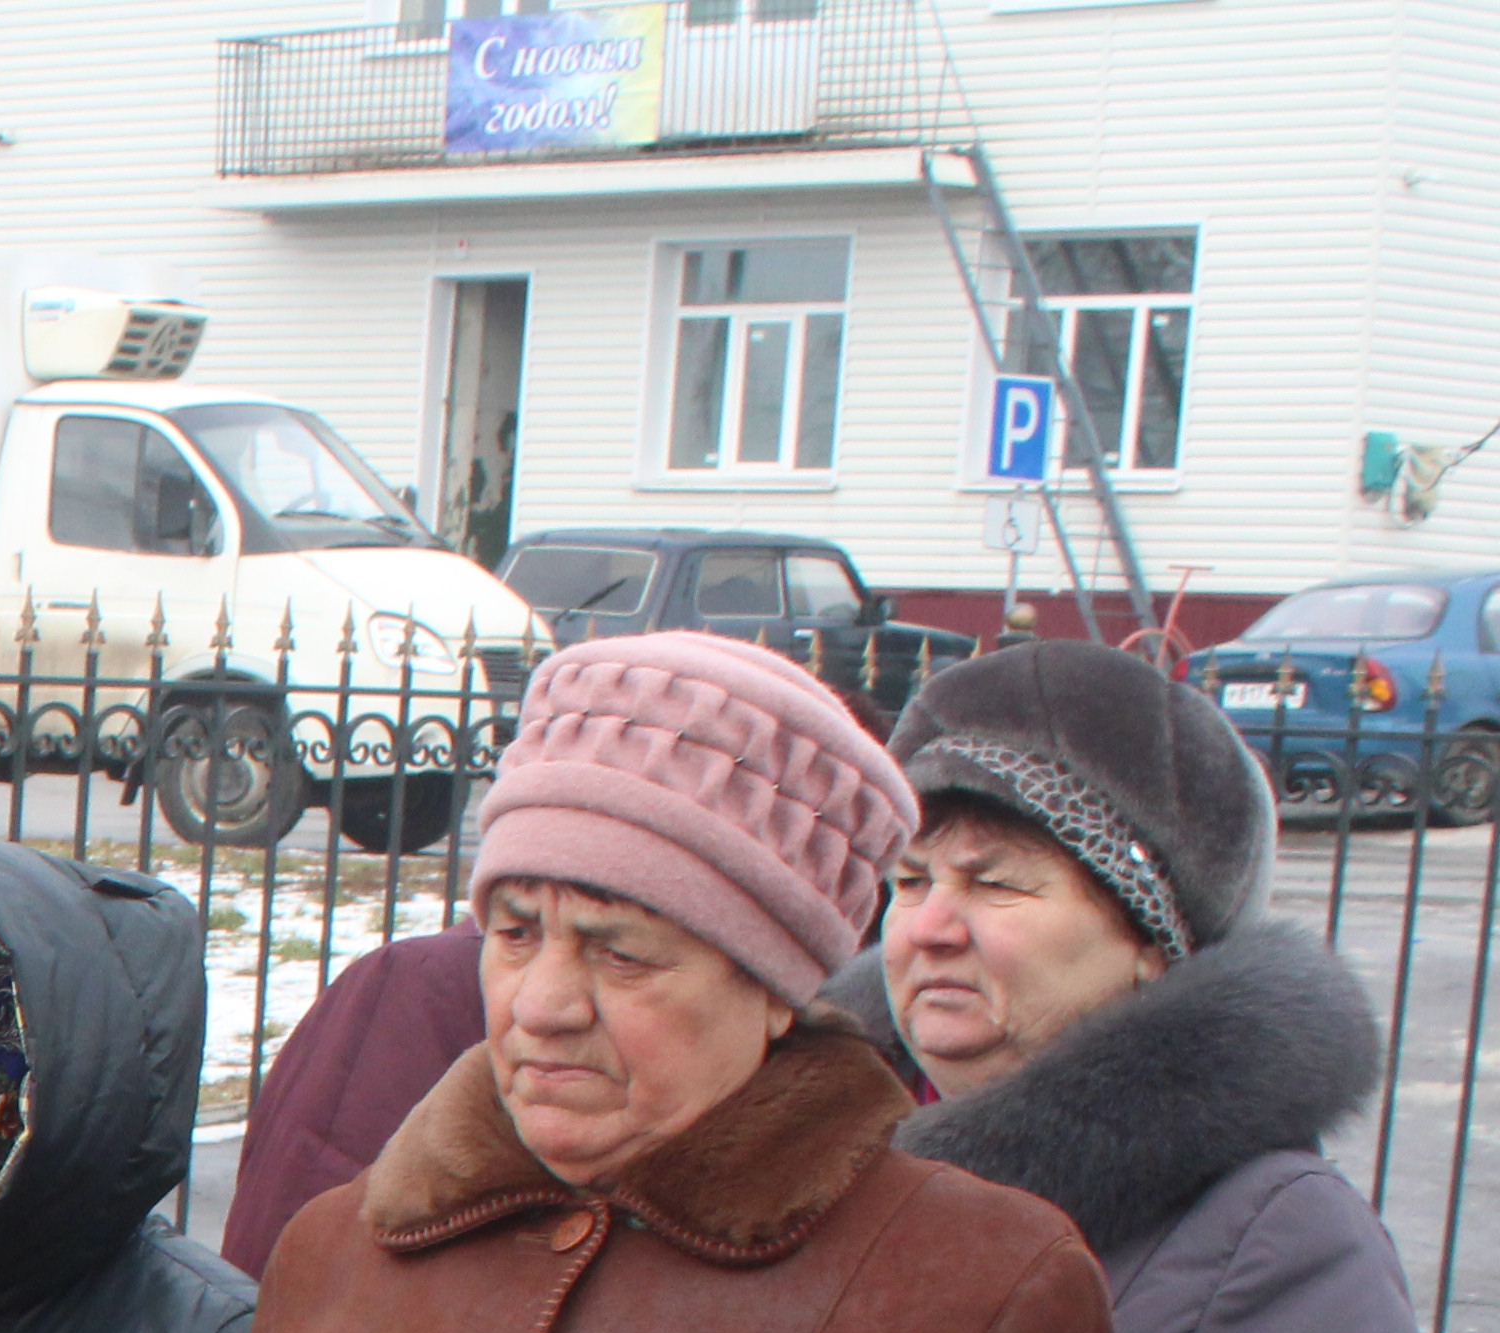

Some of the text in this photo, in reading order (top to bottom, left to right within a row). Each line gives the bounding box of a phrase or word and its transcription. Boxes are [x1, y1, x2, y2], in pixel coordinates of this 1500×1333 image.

[474, 35, 644, 80] С новым
[484, 82, 619, 135] годом!
[1001, 387, 1040, 470] P
